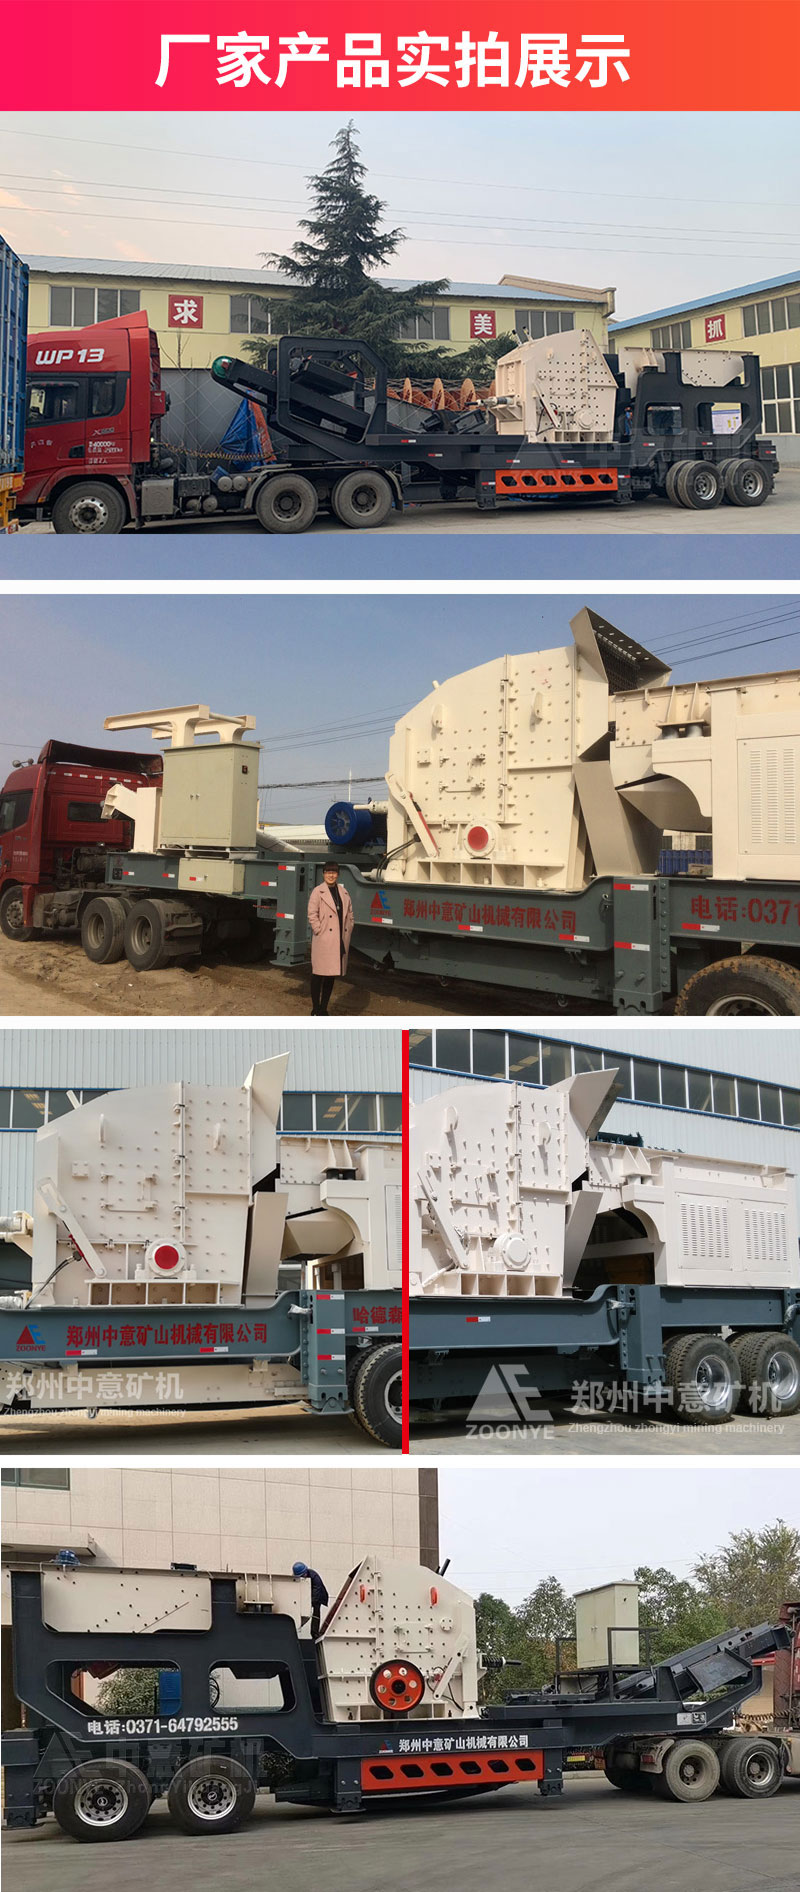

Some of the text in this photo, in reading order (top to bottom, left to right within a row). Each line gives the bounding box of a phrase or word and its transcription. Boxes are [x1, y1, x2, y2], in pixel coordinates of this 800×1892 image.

[173, 299, 198, 324] 求
[474, 313, 493, 335] 美
[707, 319, 723, 339] 抓
[403, 898, 577, 933] 郑州中意矿山机械有限公司
[66, 1323, 267, 1348] 郑州中意矿山机械有限公司
[87, 1716, 239, 1735] 电话:0371-64792555
[399, 1735, 529, 1752] 郑州中意矿山机械有限公司
